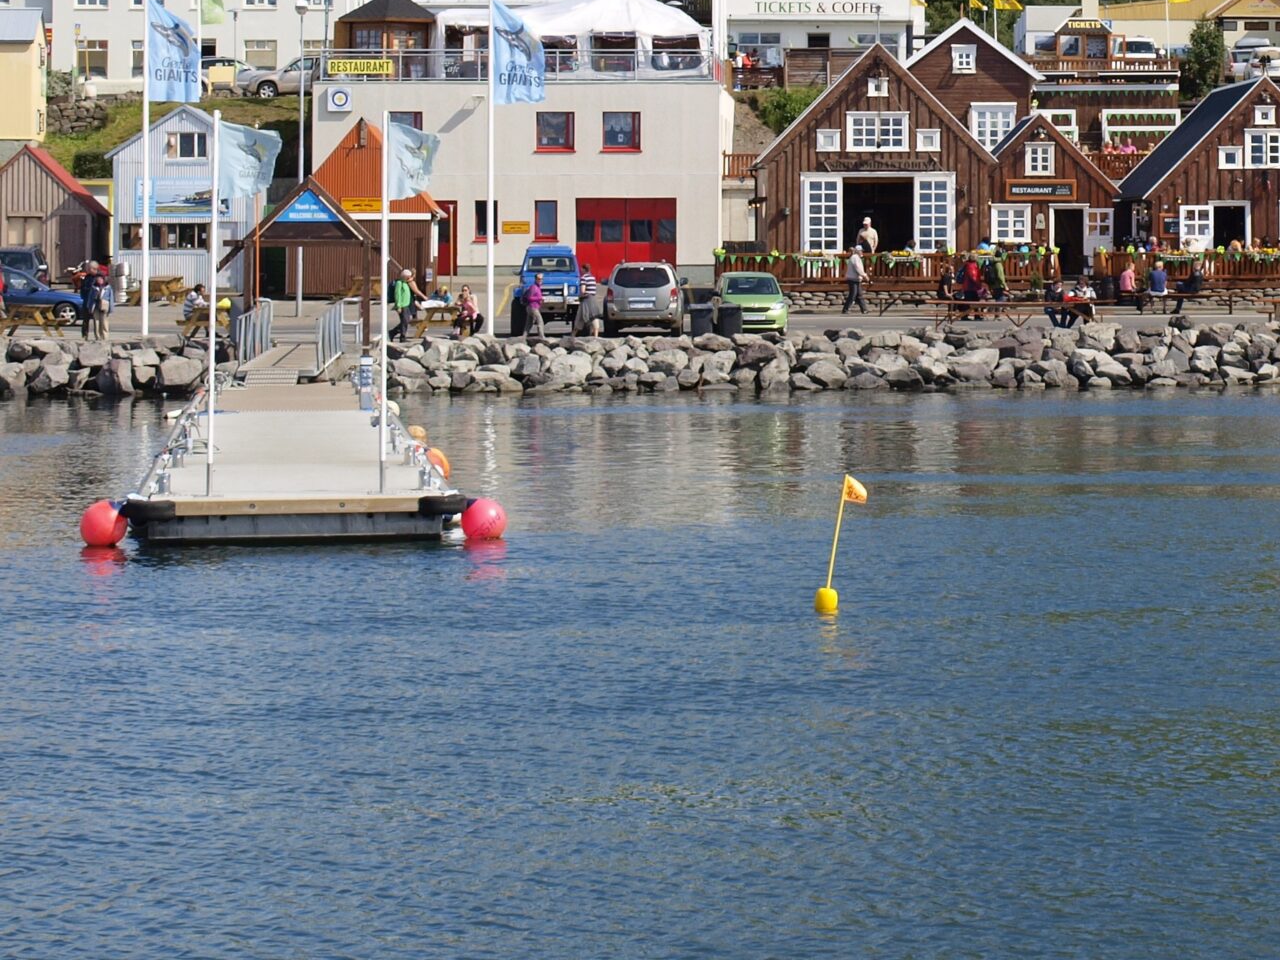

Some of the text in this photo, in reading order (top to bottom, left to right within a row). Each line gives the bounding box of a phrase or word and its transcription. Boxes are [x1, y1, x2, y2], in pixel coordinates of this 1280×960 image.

[755, 1, 812, 14] TICKETS
[816, 2, 827, 13] &
[1068, 21, 1102, 29] TICKETS
[330, 61, 391, 72] RESTAURANT
[155, 68, 199, 83] GIANTS
[499, 72, 541, 87] GIANTS
